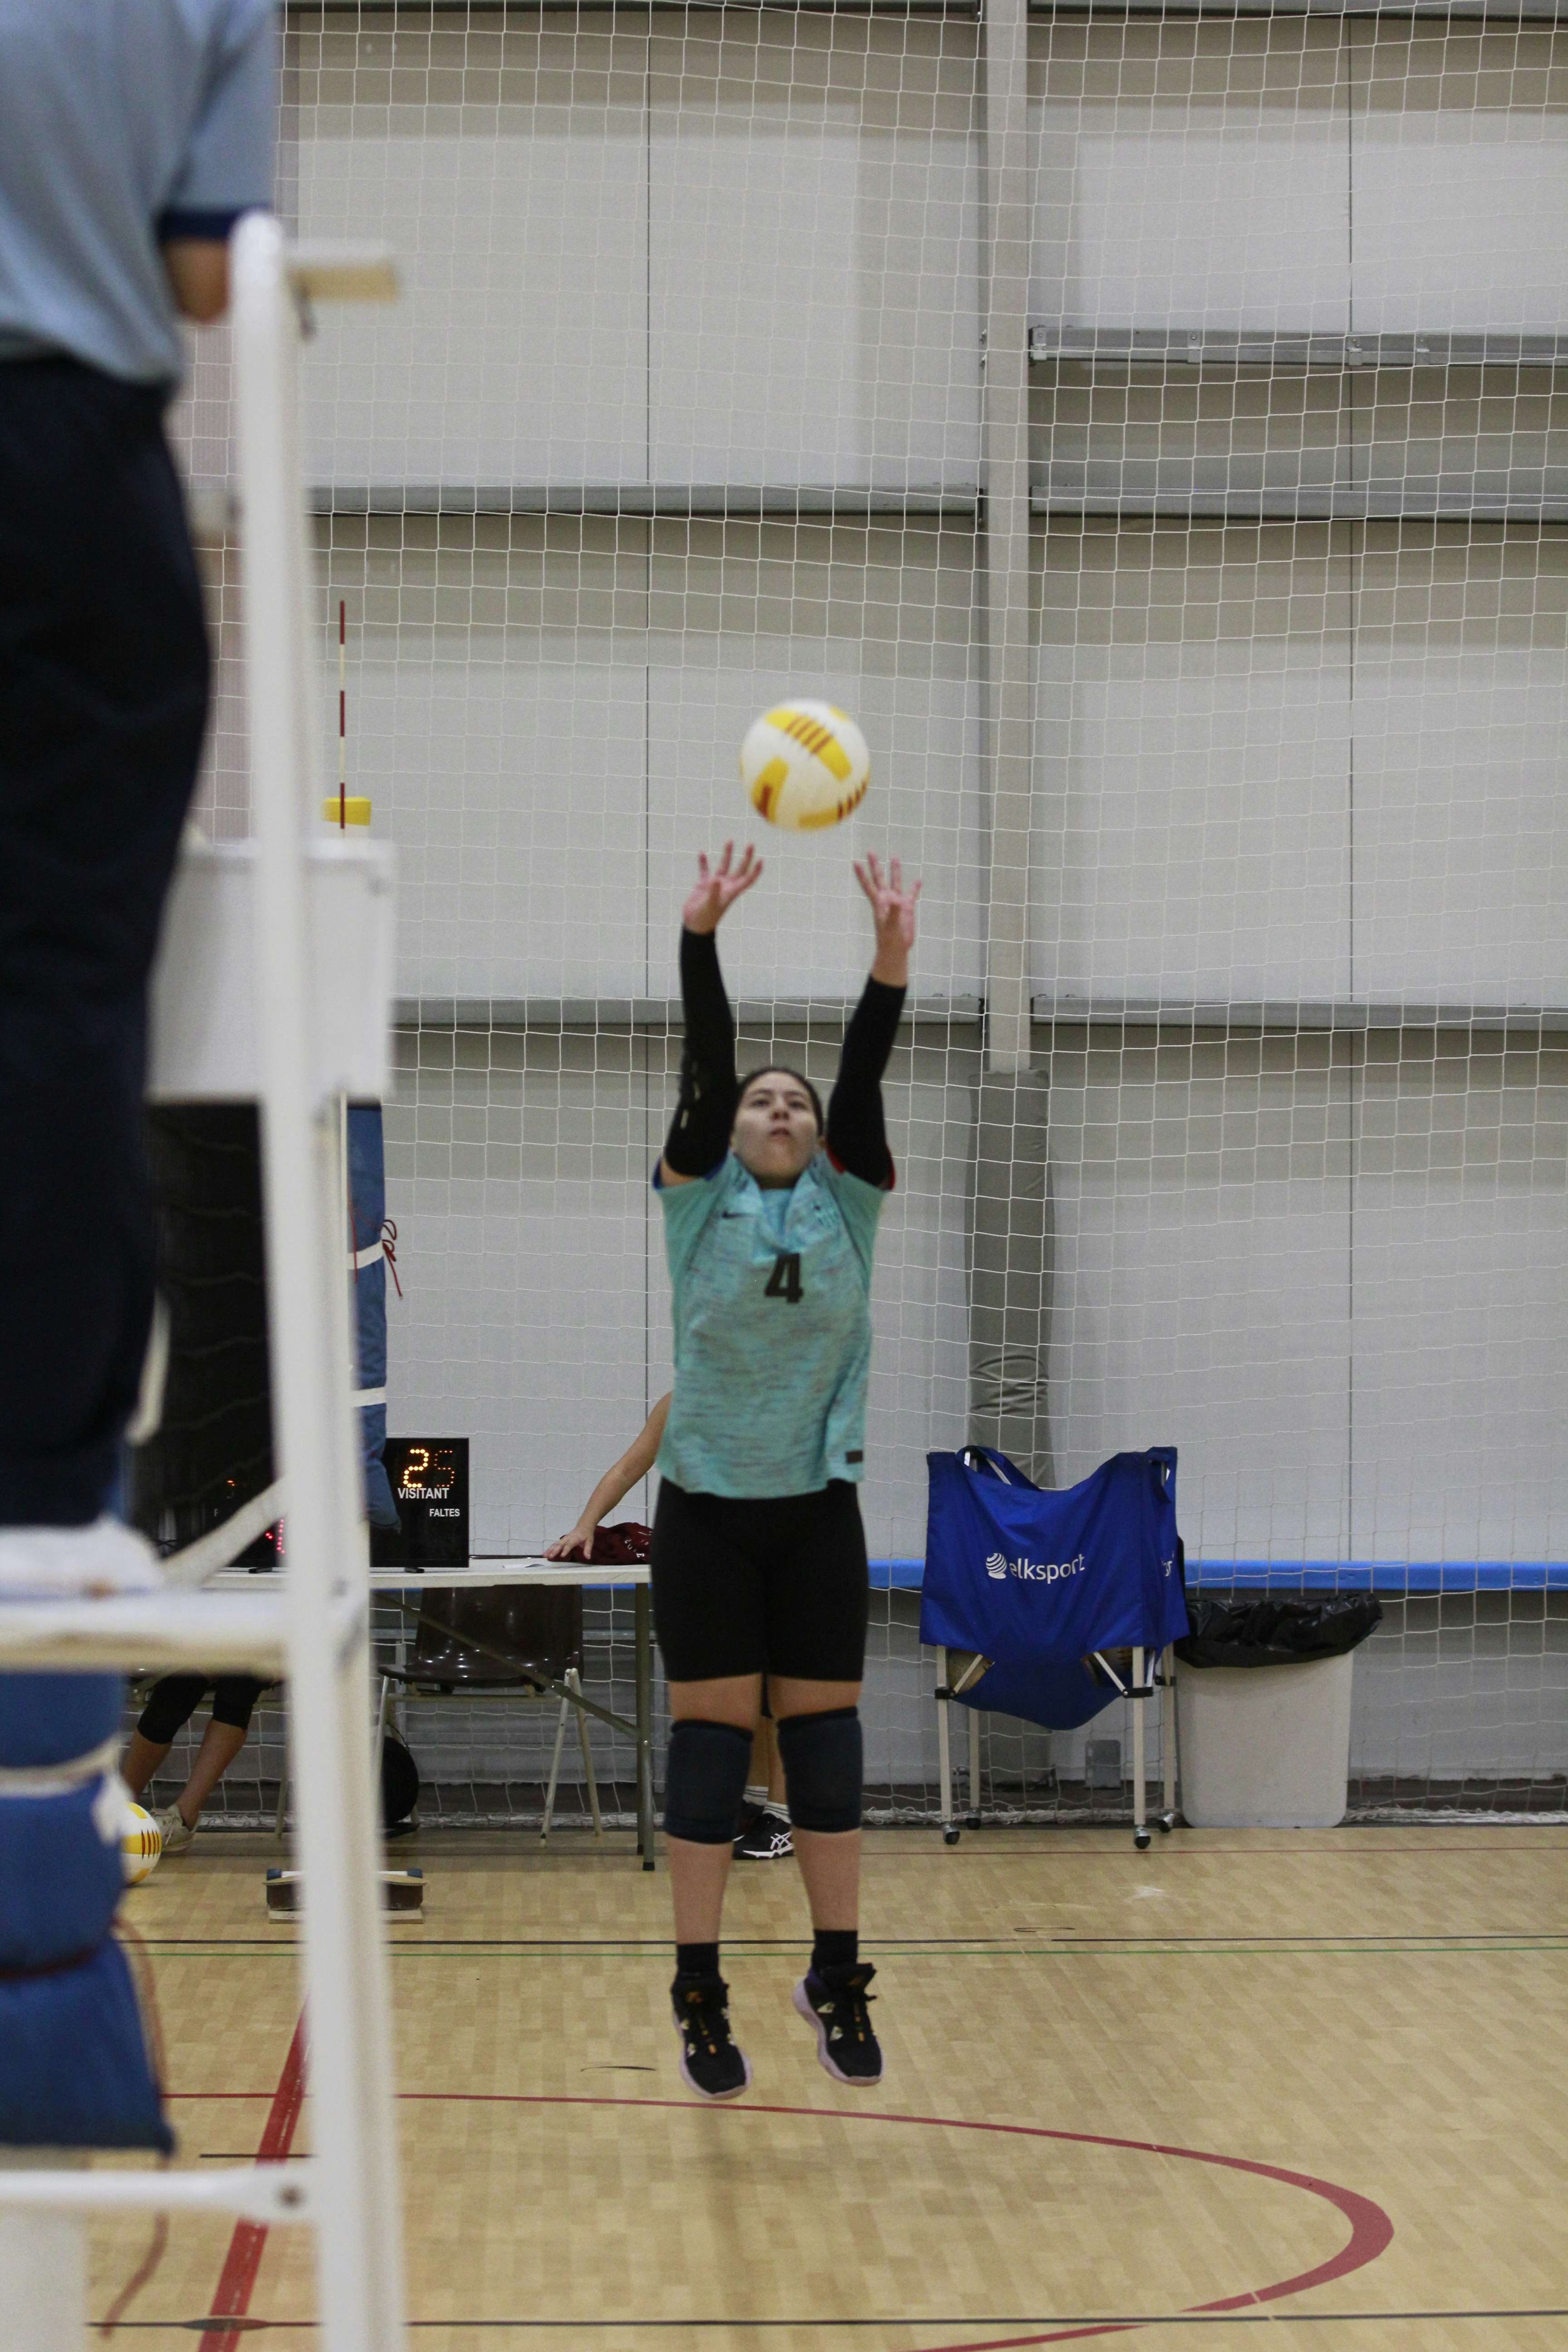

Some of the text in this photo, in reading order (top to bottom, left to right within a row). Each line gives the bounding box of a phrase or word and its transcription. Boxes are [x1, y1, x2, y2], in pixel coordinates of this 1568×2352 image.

[764, 1252, 804, 1303] 4
[402, 1449, 455, 1488] 25
[397, 1487, 450, 1499] VISITANT
[429, 1508, 461, 1517] FALTES
[1009, 1553, 1085, 1584] elksport
